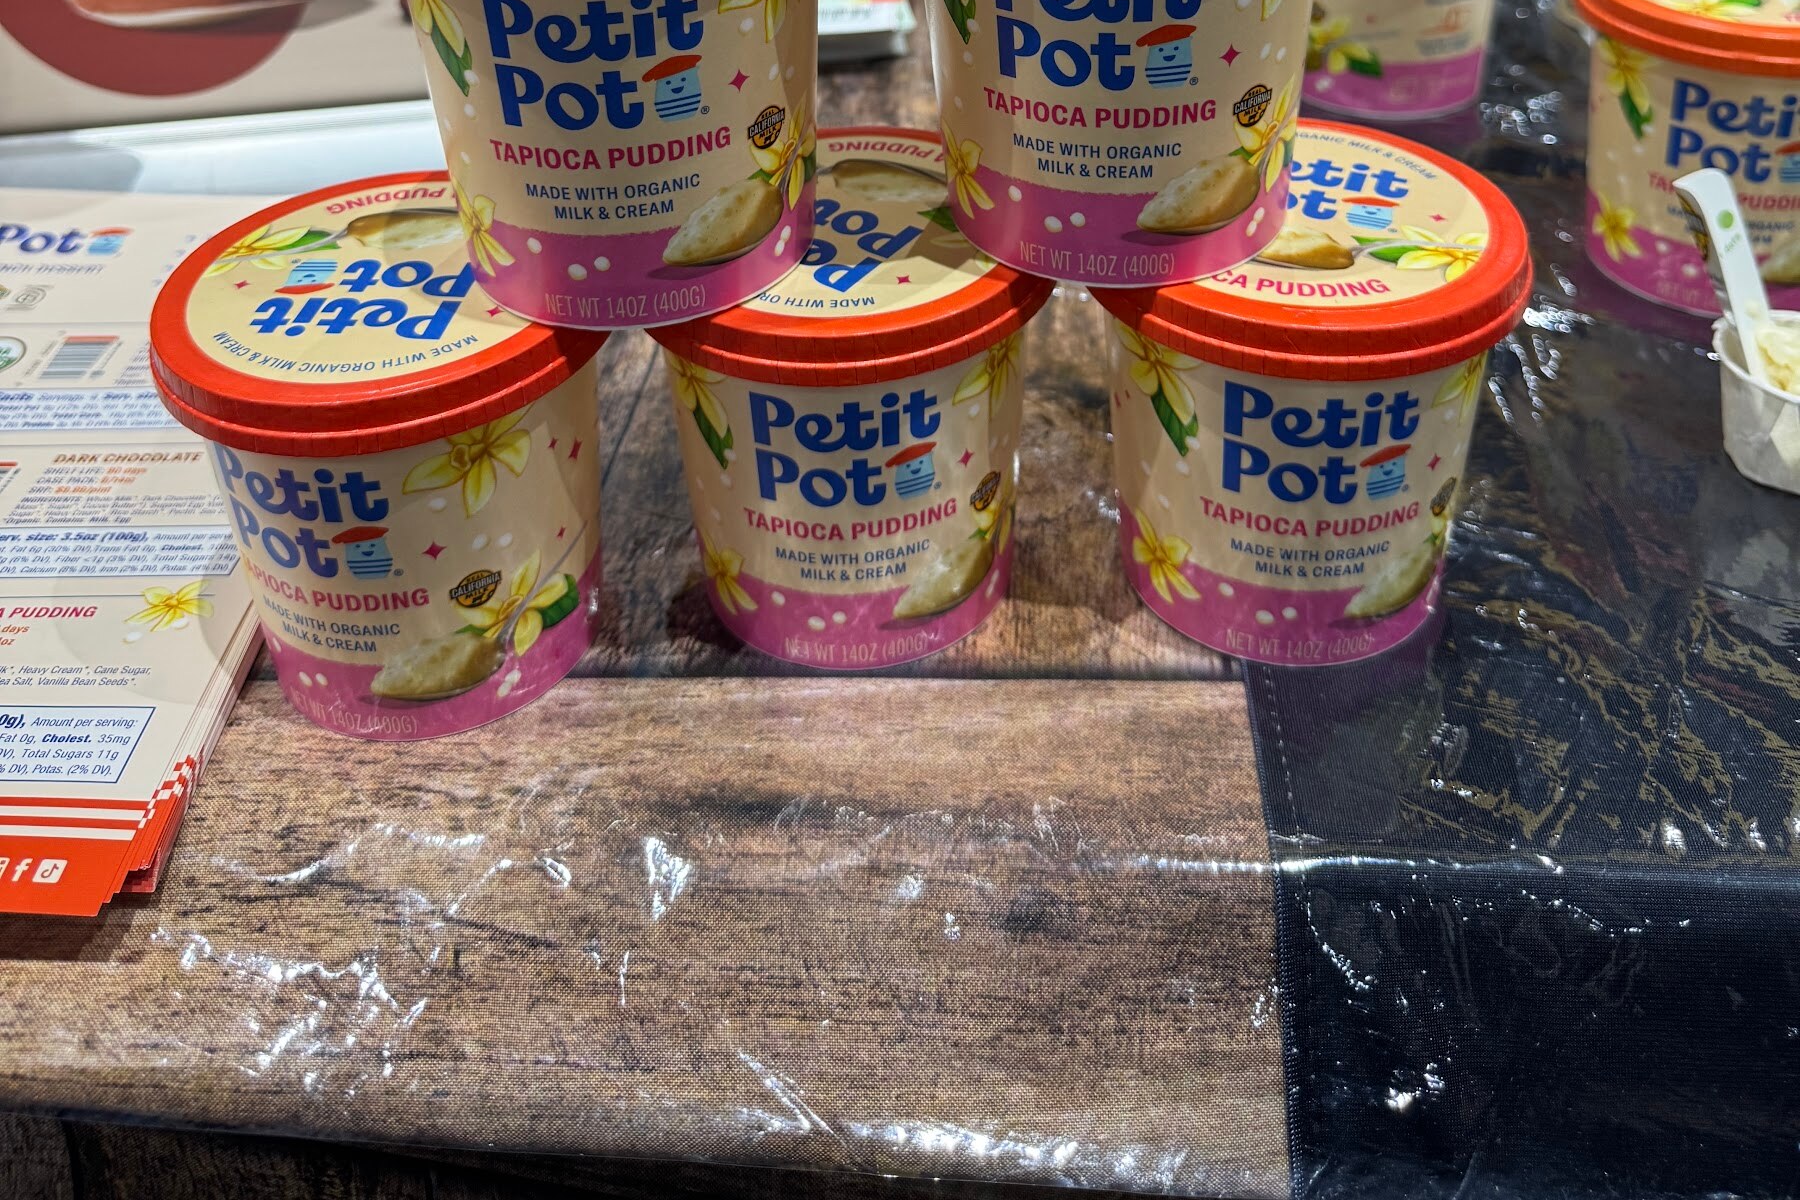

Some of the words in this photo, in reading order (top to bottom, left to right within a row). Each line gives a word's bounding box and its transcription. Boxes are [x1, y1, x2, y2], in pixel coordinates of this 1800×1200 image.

[996, 15, 1135, 91] Pot
[494, 63, 645, 130] Pot
[983, 87, 1087, 128] TAPIOCA
[1095, 99, 1217, 129] PUDDING
[1234, 91, 1271, 114] CALIFORNIA
[1670, 78, 1800, 139] Peti
[749, 110, 785, 137] CALIFORNIA
[489, 138, 600, 170] TAPIOCA
[608, 126, 732, 169] PUDDING
[827, 141, 935, 158] PUDDING
[1013, 133, 1054, 154] MADE
[1058, 142, 1101, 159] WITH
[1106, 142, 1182, 159] ORGANIC
[1665, 125, 1772, 183] Pot
[1038, 158, 1074, 176] MILK
[1079, 163, 1091, 177] &
[1095, 164, 1153, 178] CREAM
[526, 183, 571, 200] MADE
[575, 186, 619, 201] WITH
[624, 173, 700, 198] ORGANIC
[326, 187, 447, 215] PUDDING
[554, 205, 594, 220] MILK
[598, 205, 611, 220] &
[615, 199, 674, 219] CREAM
[1020, 240, 1047, 271] NET
[1049, 250, 1072, 273] WT
[1123, 252, 1175, 277] (400G)
[339, 259, 477, 298] Pot
[1255, 278, 1391, 298] PUDDING
[545, 293, 574, 317] NET
[577, 296, 600, 318] WT
[654, 284, 706, 315] (400G)
[784, 296, 824, 308] WITH
[830, 296, 875, 307] MADE
[249, 297, 462, 340] Petit
[213, 330, 251, 359] CREAM
[430, 335, 478, 357] MADE
[258, 352, 297, 372] MILK
[298, 361, 376, 373] ORGANIC
[382, 352, 426, 368] WITH
[749, 389, 941, 453] Petit
[1224, 380, 1420, 449] Petit
[53, 452, 98, 464] DARK
[1222, 438, 1358, 504] Pot
[213, 440, 389, 523] Petit
[755, 448, 887, 508] Pot
[743, 507, 844, 541] TAPIOCA
[851, 497, 957, 540] PUDDING
[1199, 495, 1308, 537] TAPIOCA
[1314, 501, 1420, 537] PUDDING
[228, 492, 339, 578] Pot
[776, 546, 817, 564] MADE
[820, 551, 859, 565] WITH
[864, 538, 930, 563] ORGANIC
[1230, 538, 1274, 558] MADE
[1279, 548, 1319, 561] WITH
[1324, 540, 1390, 561] ORGANIC
[800, 567, 835, 581] MILK
[840, 569, 850, 582] &
[855, 563, 907, 581] CREAM
[1255, 560, 1293, 577] MILK
[1296, 565, 1308, 578] &
[1312, 562, 1365, 577] CREAM
[452, 572, 501, 598] CALIFORNIA
[8, 605, 98, 618] PUDDING
[314, 587, 430, 613] PUDDING
[1, 624, 30, 635] days
[292, 612, 327, 631] WITH
[331, 622, 401, 636] ORGANIC
[325, 636, 377, 652] CREAM
[814, 643, 837, 661] WT
[1225, 628, 1253, 650] NET
[1257, 638, 1281, 657] WT
[12, 676, 33, 687] Salt,
[37, 676, 70, 686] Vanilla
[71, 677, 97, 686] Bean
[18, 665, 49, 676] Heavy
[94, 665, 119, 675] Cane
[121, 665, 151, 677] Sugar,
[30, 716, 74, 727] Amount
[74, 718, 93, 729] per
[95, 716, 139, 729] serving:
[41, 733, 92, 743] Cholest.
[97, 733, 132, 746] 35mg
[22, 748, 53, 758] Total
[52, 748, 94, 760] Sugars
[97, 749, 119, 761] 11g
[32, 763, 64, 774] Potas.
